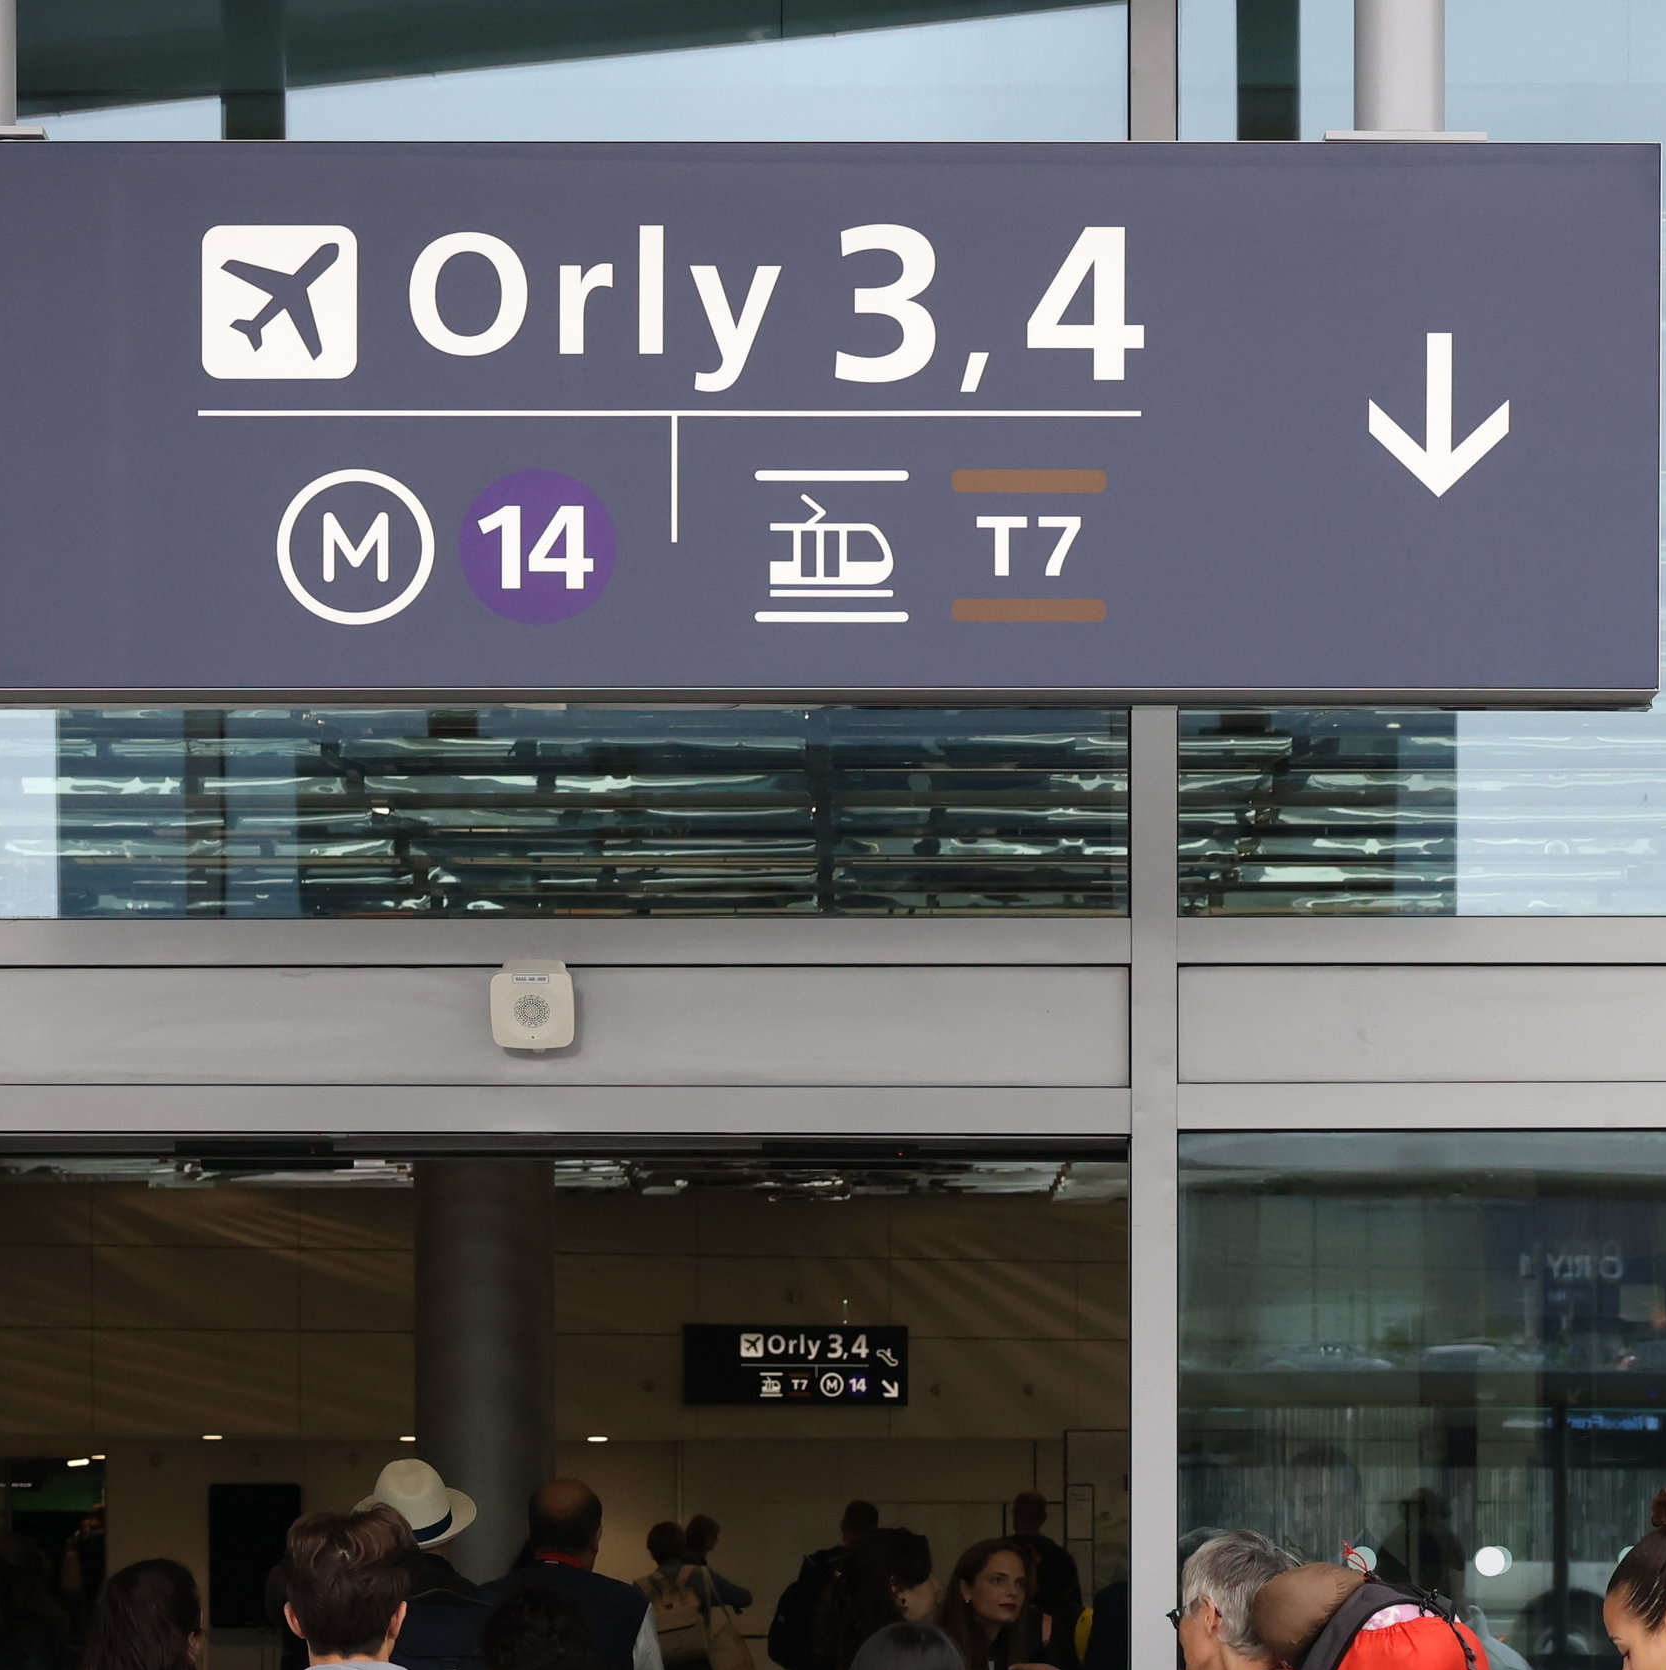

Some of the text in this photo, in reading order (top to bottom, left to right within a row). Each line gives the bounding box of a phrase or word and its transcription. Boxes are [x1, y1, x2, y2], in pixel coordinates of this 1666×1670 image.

[410, 223, 1145, 393] Orly 3,4
[477, 505, 594, 590] 14
[976, 515, 1082, 577] T7
[767, 1333, 870, 1360] Orly 3,4
[791, 1379, 808, 1391] T7
[849, 1377, 867, 1392] 14
